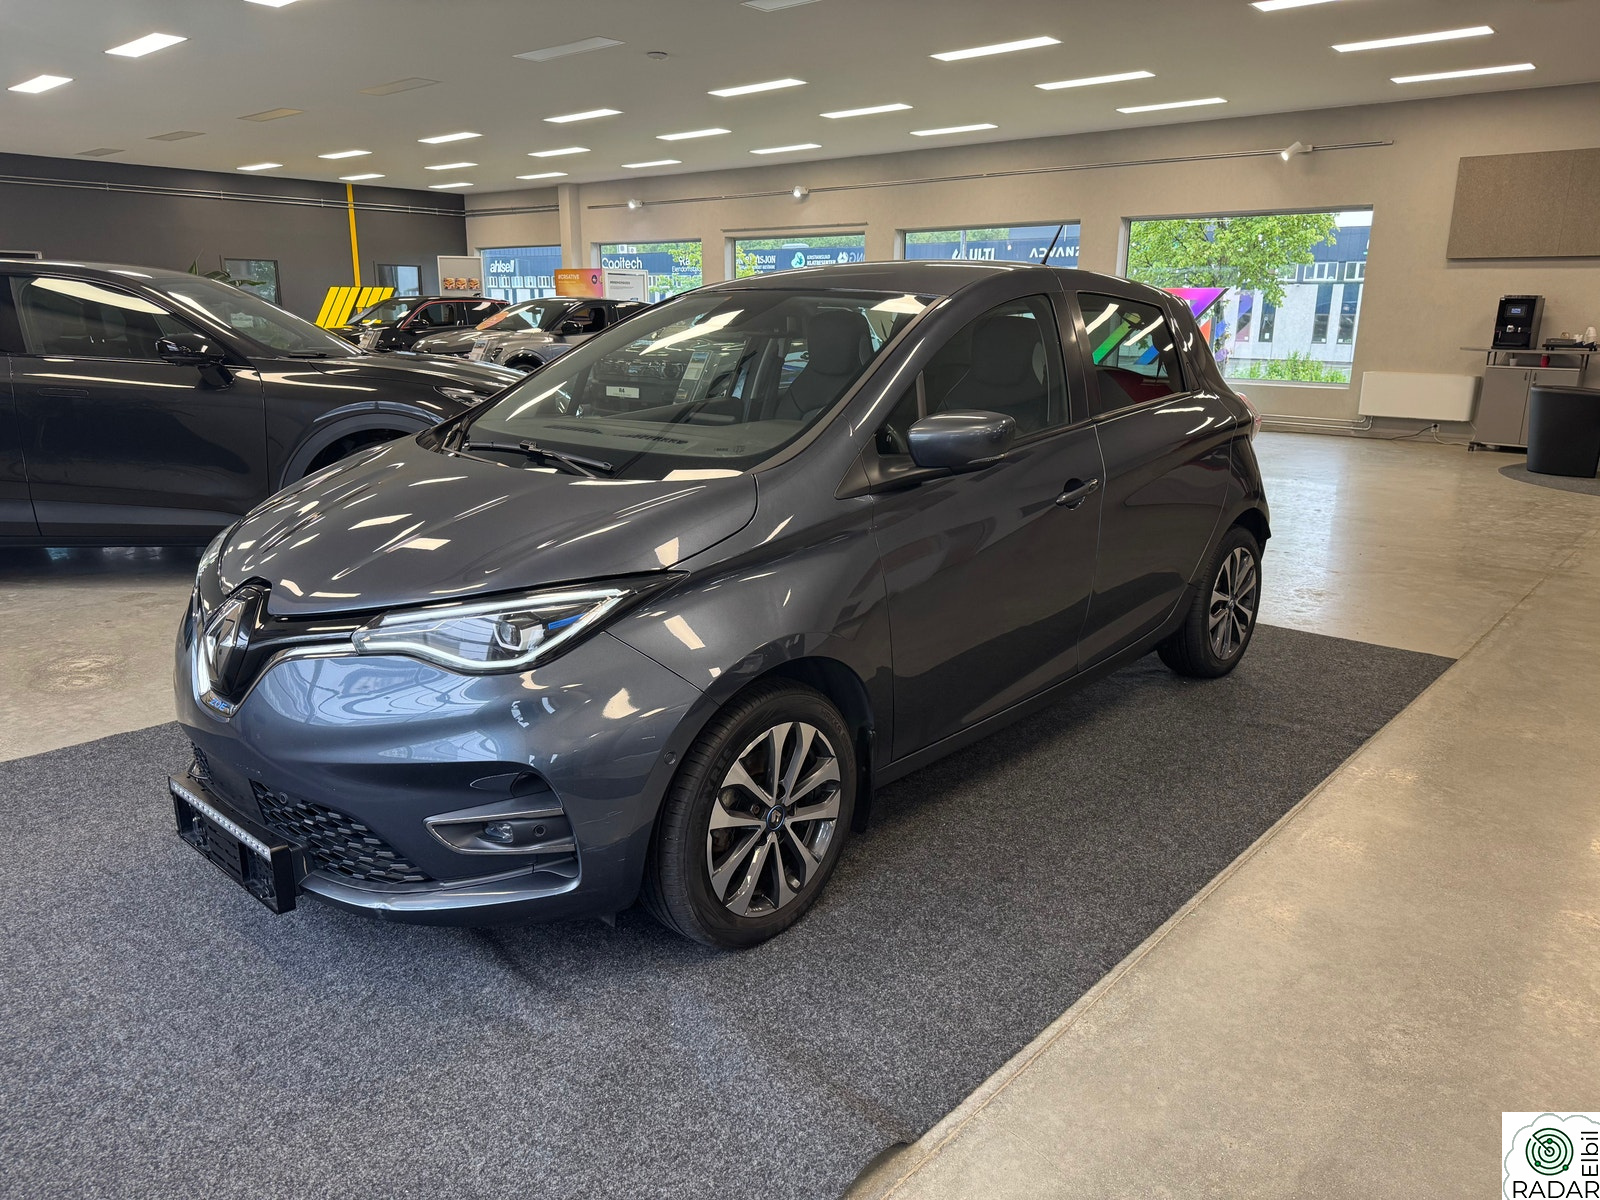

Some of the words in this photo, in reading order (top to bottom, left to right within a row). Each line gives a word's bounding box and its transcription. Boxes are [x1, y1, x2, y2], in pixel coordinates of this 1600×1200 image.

[490, 259, 515, 273] ahlsell
[601, 257, 643, 269] Cooltech
[209, 697, 228, 711] ZOE
